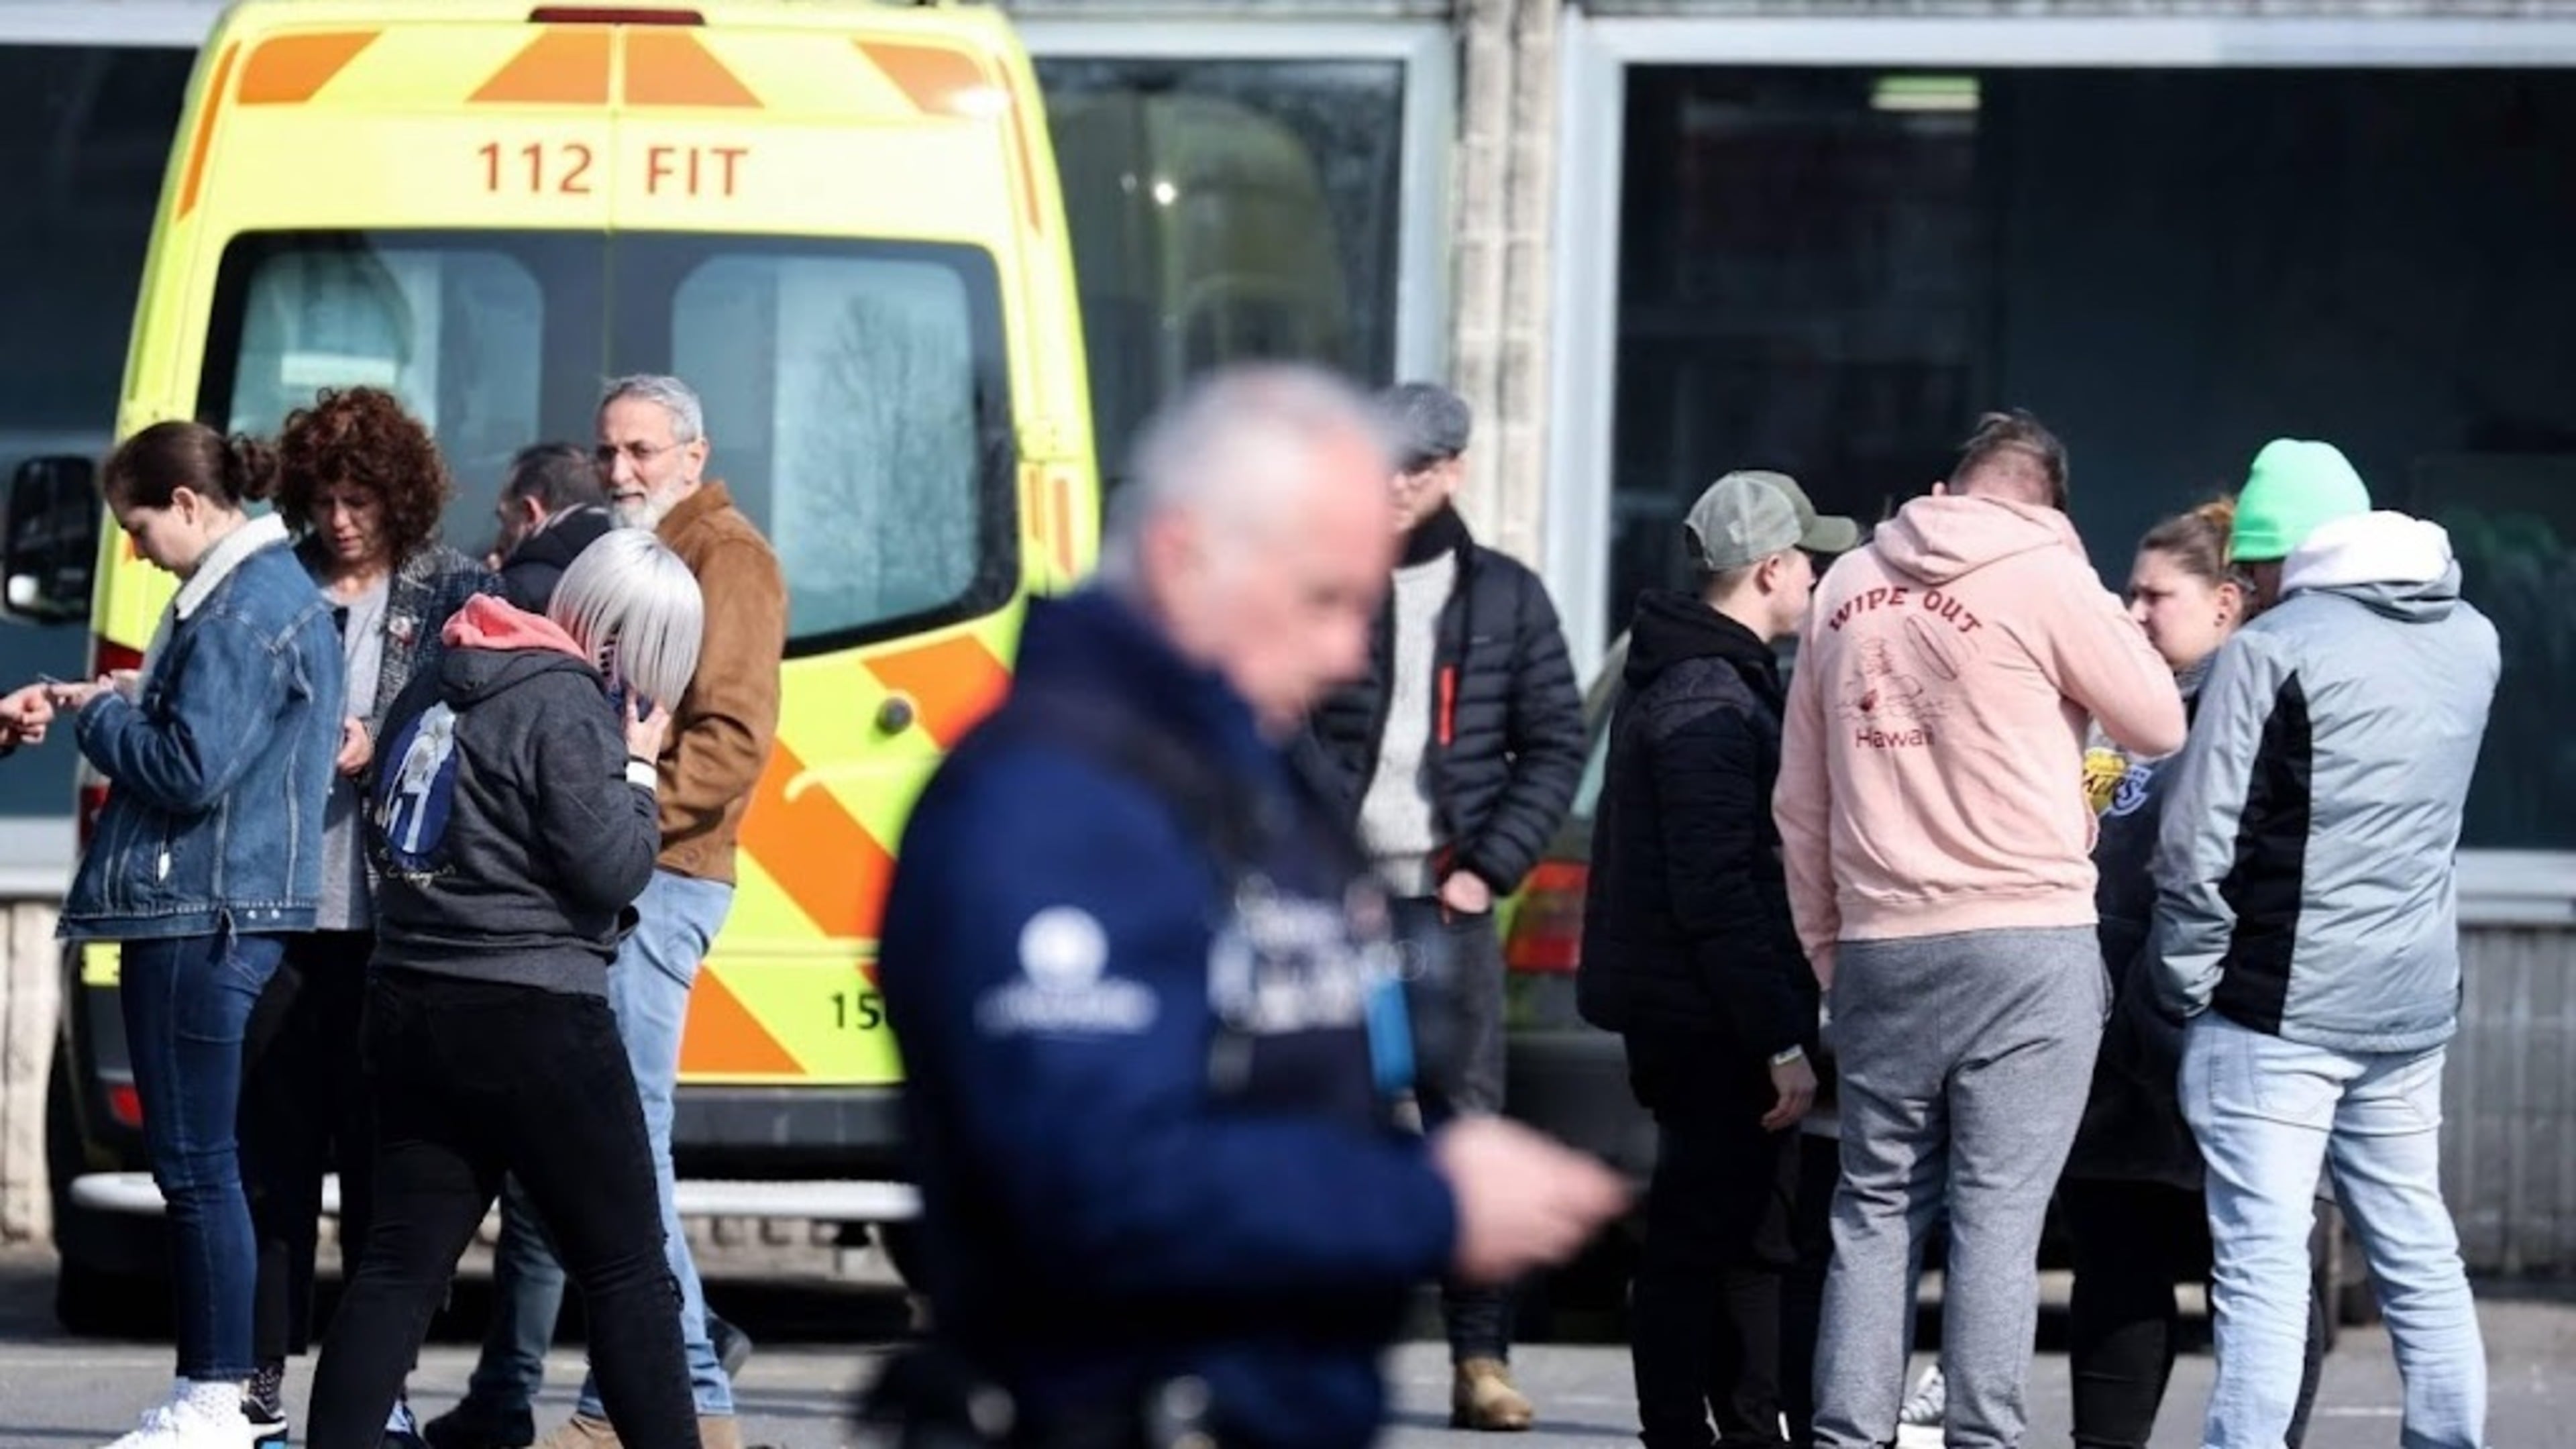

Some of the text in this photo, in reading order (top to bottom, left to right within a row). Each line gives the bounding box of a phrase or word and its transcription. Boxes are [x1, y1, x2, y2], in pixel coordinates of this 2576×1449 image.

[478, 142, 749, 195] 112 FIT
[1829, 586, 1982, 633] WIPE OUT
[830, 991, 882, 1030] 15
